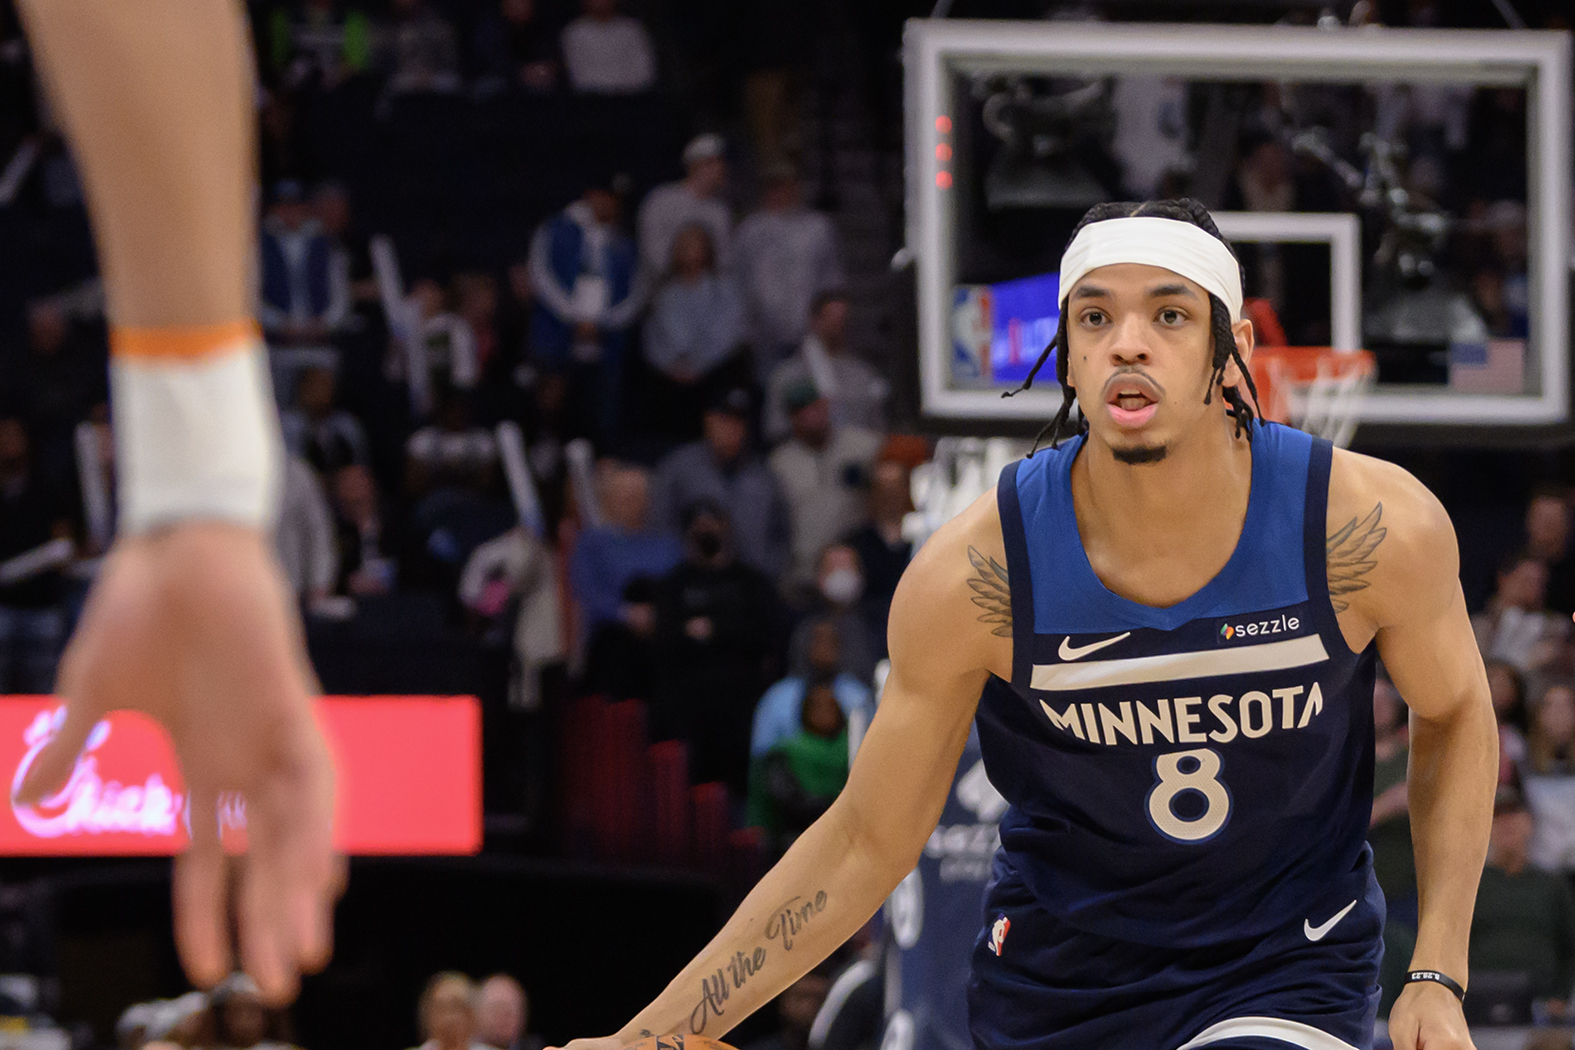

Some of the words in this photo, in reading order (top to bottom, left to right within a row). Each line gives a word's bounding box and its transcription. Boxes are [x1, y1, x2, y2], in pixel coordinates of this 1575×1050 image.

[1235, 614, 1300, 637] sezzle
[1037, 681, 1324, 745] MINNESOTA
[1144, 747, 1234, 844] 8
[690, 968, 730, 1035] All
[727, 946, 766, 988] the
[763, 889, 828, 951] Time
